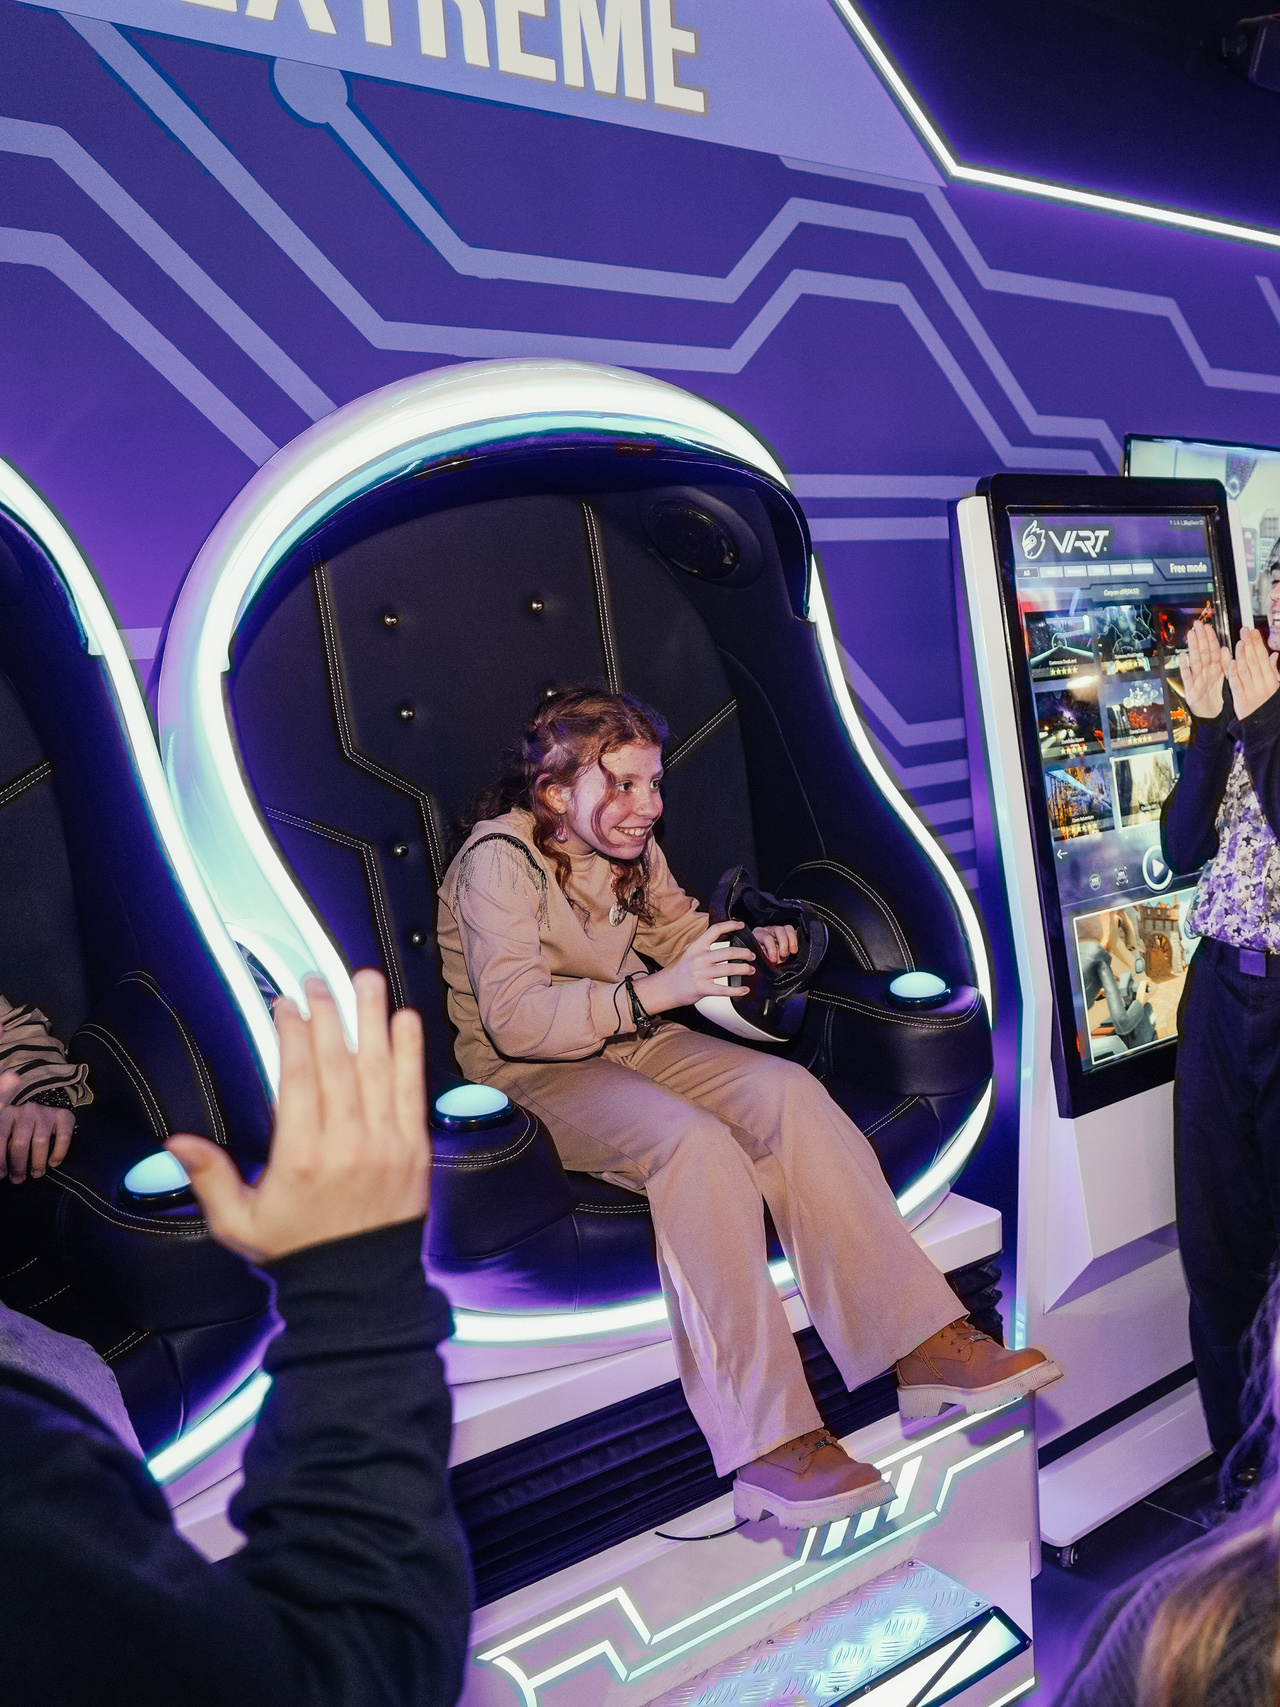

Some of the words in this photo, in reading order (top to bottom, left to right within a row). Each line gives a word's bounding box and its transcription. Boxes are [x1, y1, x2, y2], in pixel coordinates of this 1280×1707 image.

[181, 0, 708, 114] REME
[1047, 529, 1110, 558] VART
[1169, 562, 1186, 574] Free
[1186, 561, 1208, 573] mode
